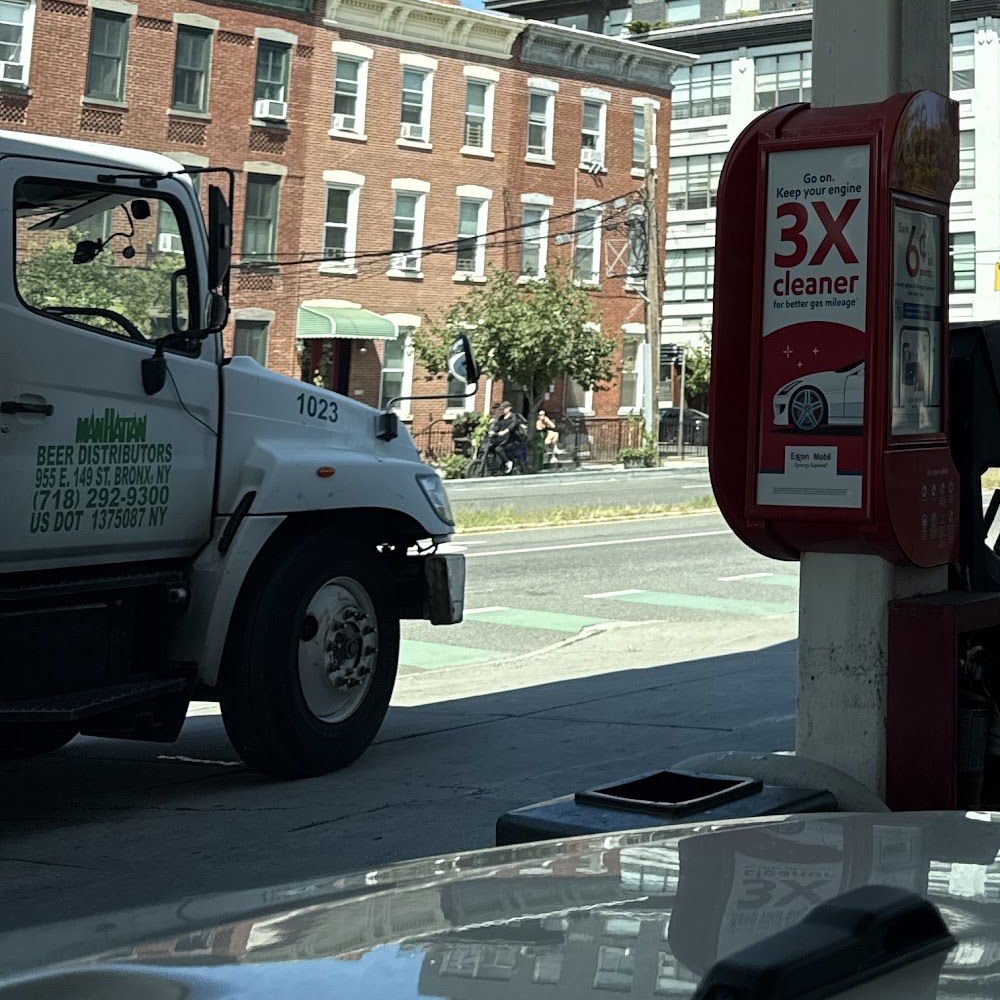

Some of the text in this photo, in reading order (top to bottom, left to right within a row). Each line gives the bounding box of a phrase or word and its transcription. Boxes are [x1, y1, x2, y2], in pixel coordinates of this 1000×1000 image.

[776, 182, 862, 200] Keep your engine
[803, 173, 835, 184] Go on.
[774, 198, 862, 268] 3X
[773, 270, 860, 297] cleaner
[773, 299, 784, 309] for
[785, 298, 808, 309] better
[809, 300, 823, 310] gas
[297, 392, 339, 423] 1023
[75, 408, 147, 443] MANHATTAN
[37, 443, 172, 466] BEER DISTRIBUTORS
[790, 452, 832, 462] Exxon Mobil
[35, 464, 172, 489] 955 E. 149 ST. BRONX, NY
[32, 485, 169, 510] (718) 292-9300
[30, 506, 168, 533] US DOT 1375087 NY
